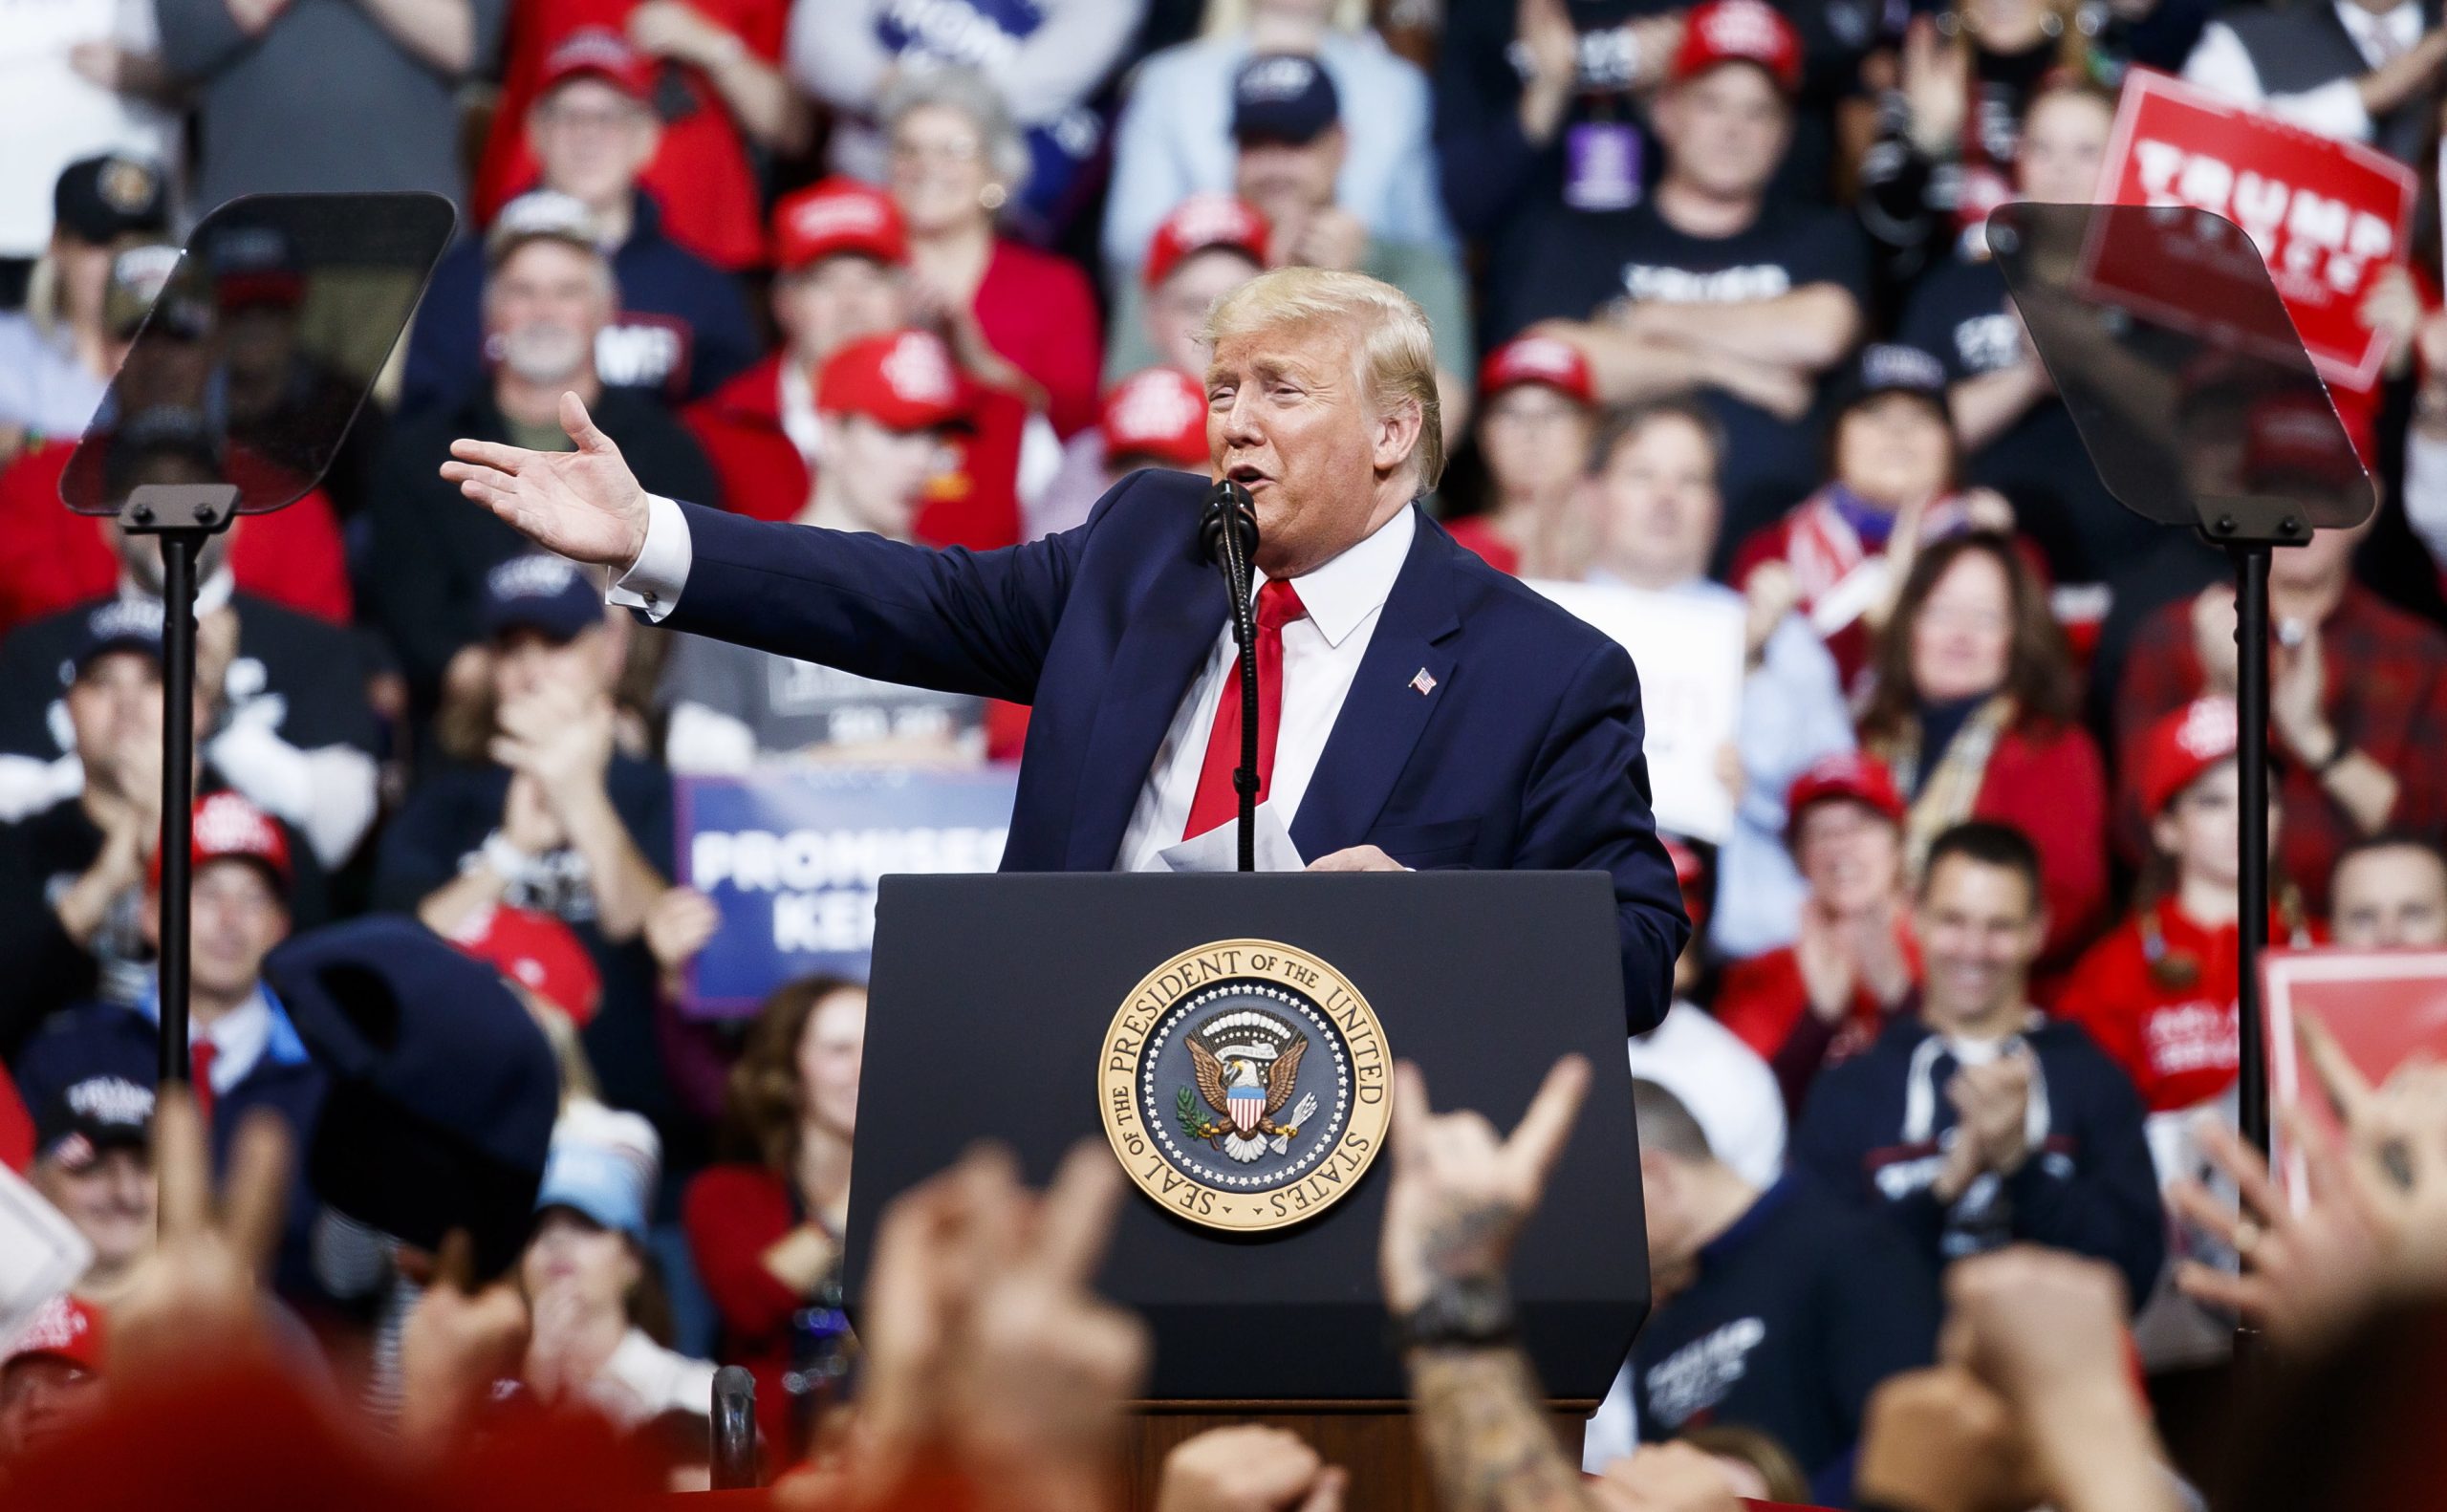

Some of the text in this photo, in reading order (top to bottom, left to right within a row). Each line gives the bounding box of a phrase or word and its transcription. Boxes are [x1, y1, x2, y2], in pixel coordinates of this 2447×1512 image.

[2135, 139, 2392, 260] TRUMP
[1110, 950, 1383, 1217] SEAL OF THE PRESIDENT OF THE UNITED STATES
